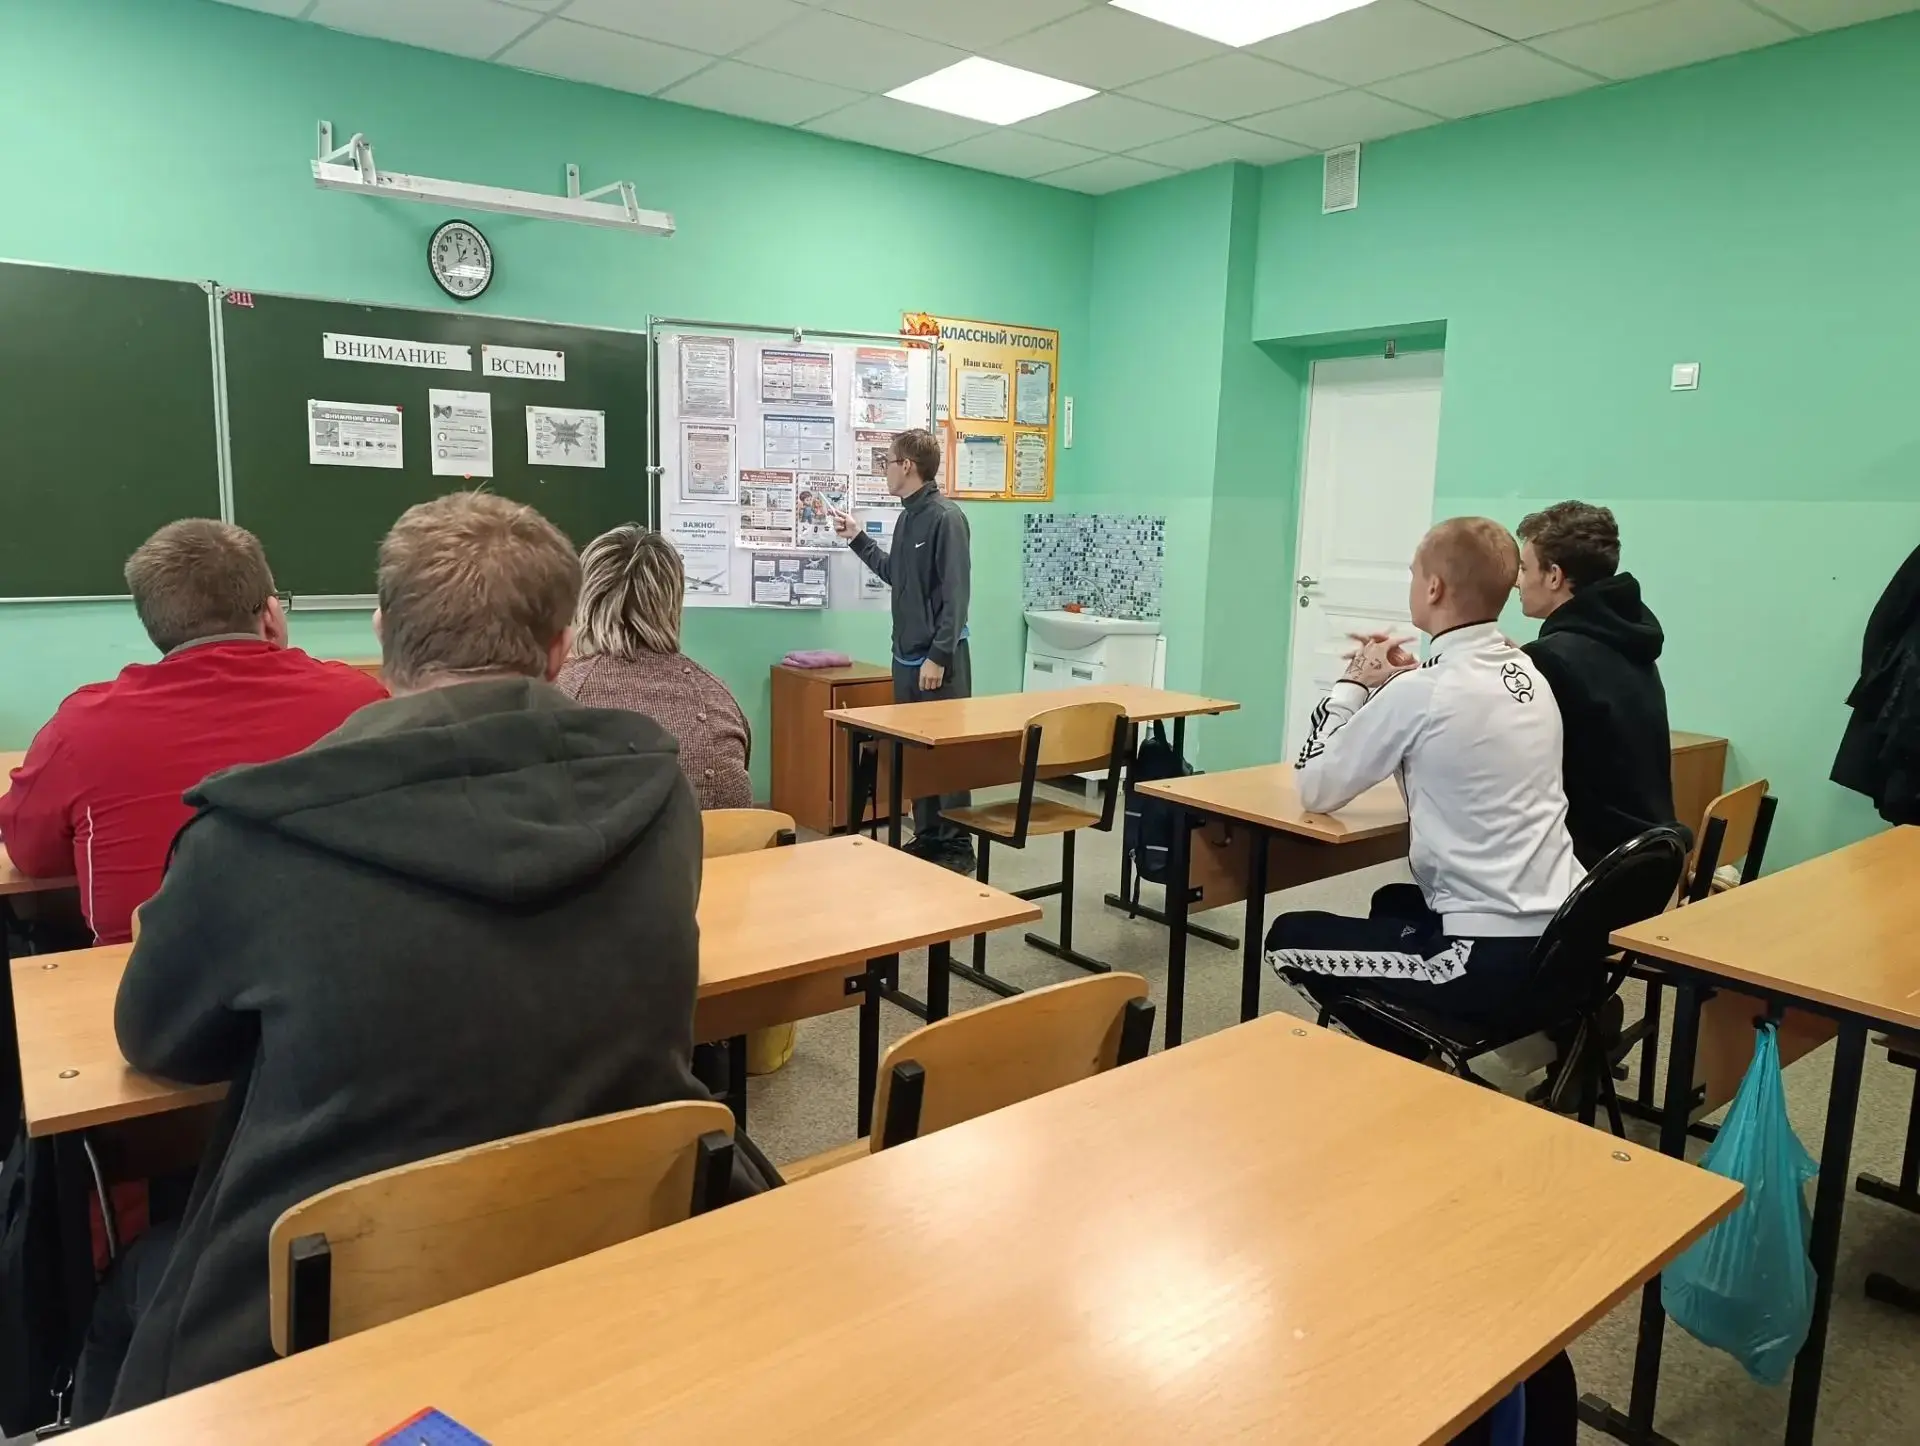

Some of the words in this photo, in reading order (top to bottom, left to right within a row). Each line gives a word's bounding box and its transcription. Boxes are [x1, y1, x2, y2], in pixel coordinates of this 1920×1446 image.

[941, 326, 1007, 345] КЛАССНЫЙ
[1010, 333, 1053, 350] УГОЛОК
[335, 340, 448, 365] ВНИМАНИЕ
[491, 358, 557, 376] ВСЕМ!!!
[963, 358, 981, 367] Наш
[982, 362, 1003, 370] класс
[683, 521, 715, 529] ВАЖНО!
